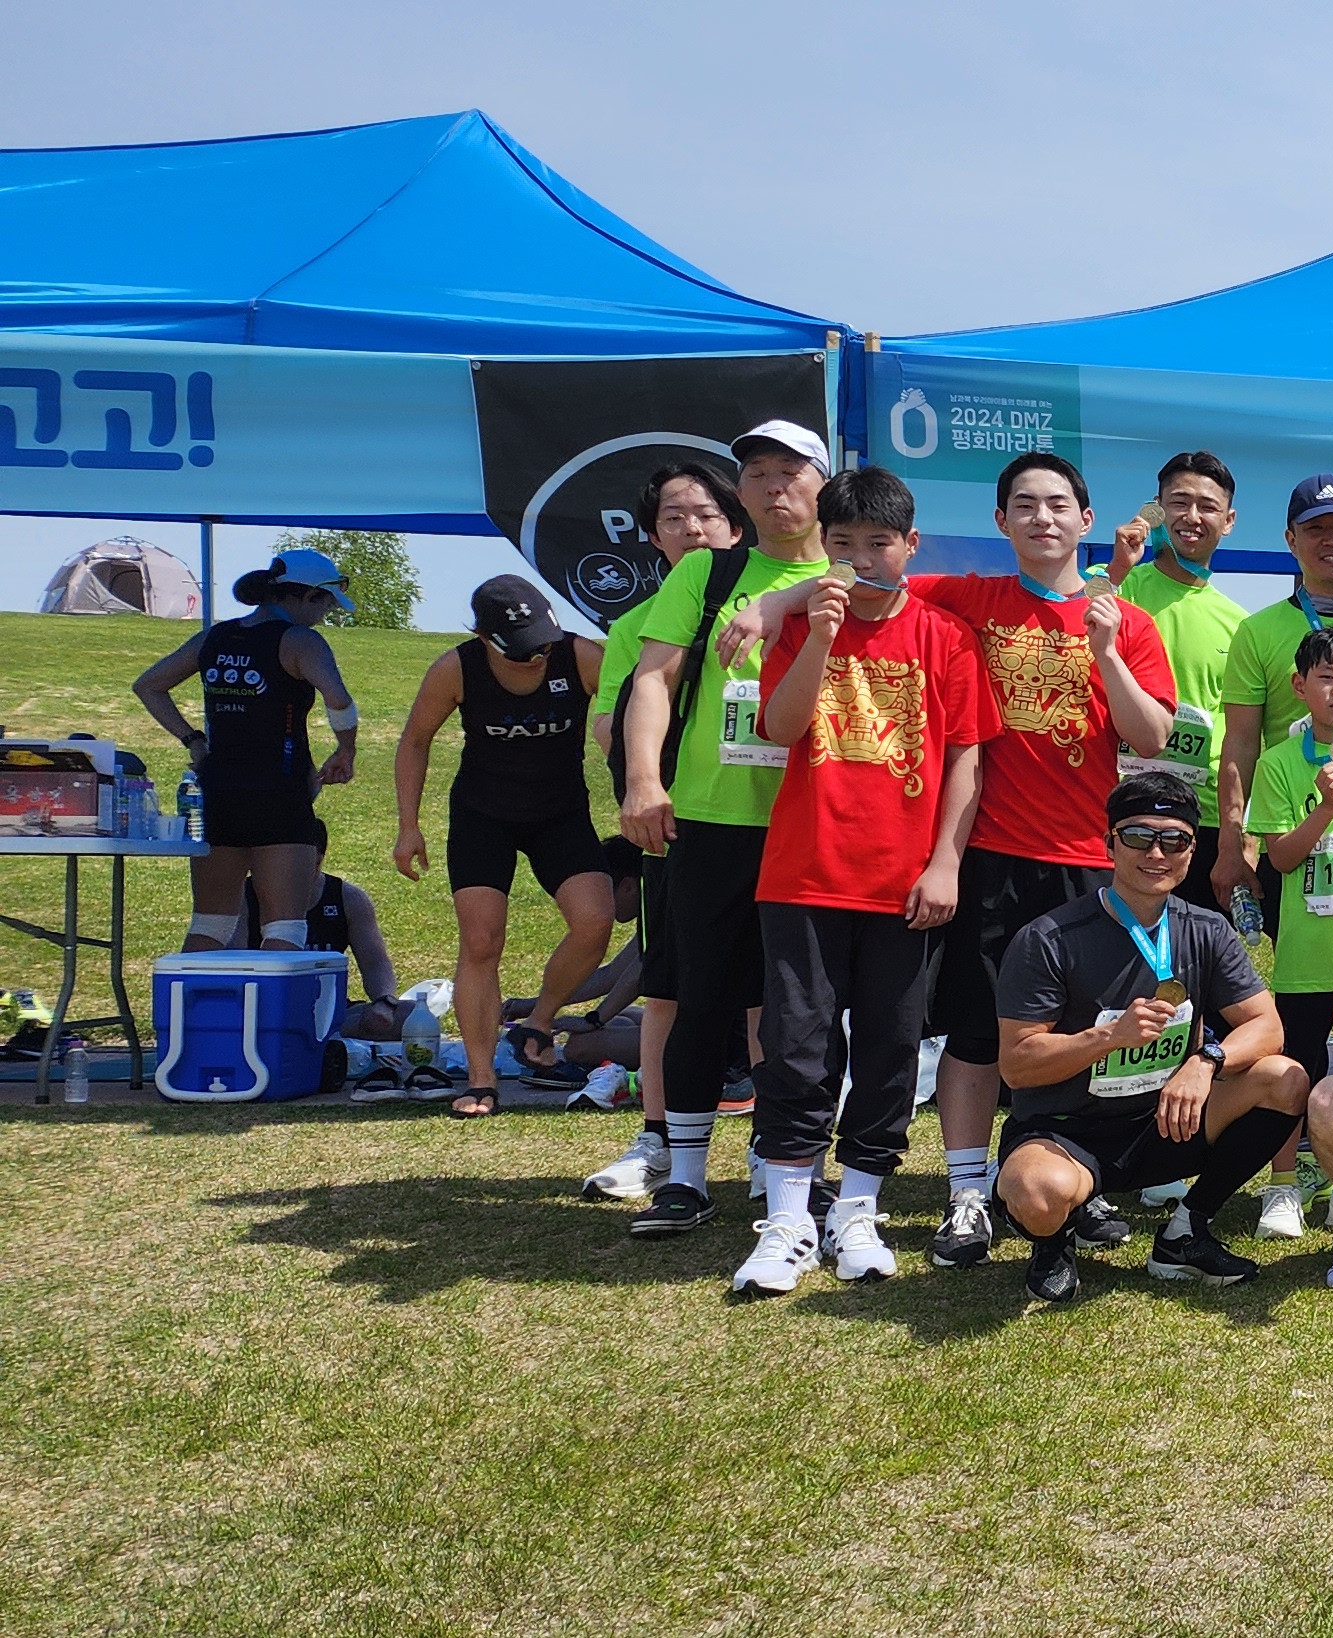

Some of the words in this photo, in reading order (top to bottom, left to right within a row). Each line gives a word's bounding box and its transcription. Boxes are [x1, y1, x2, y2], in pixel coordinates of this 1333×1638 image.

[951, 407, 1005, 428] 2024
[1010, 411, 1054, 431] DMZ
[951, 429, 1055, 454] 평화마라톤
[216, 653, 251, 668] PAJU
[485, 718, 572, 738] PAJU
[1166, 731, 1206, 757] 437
[1117, 1034, 1184, 1067] 10436
